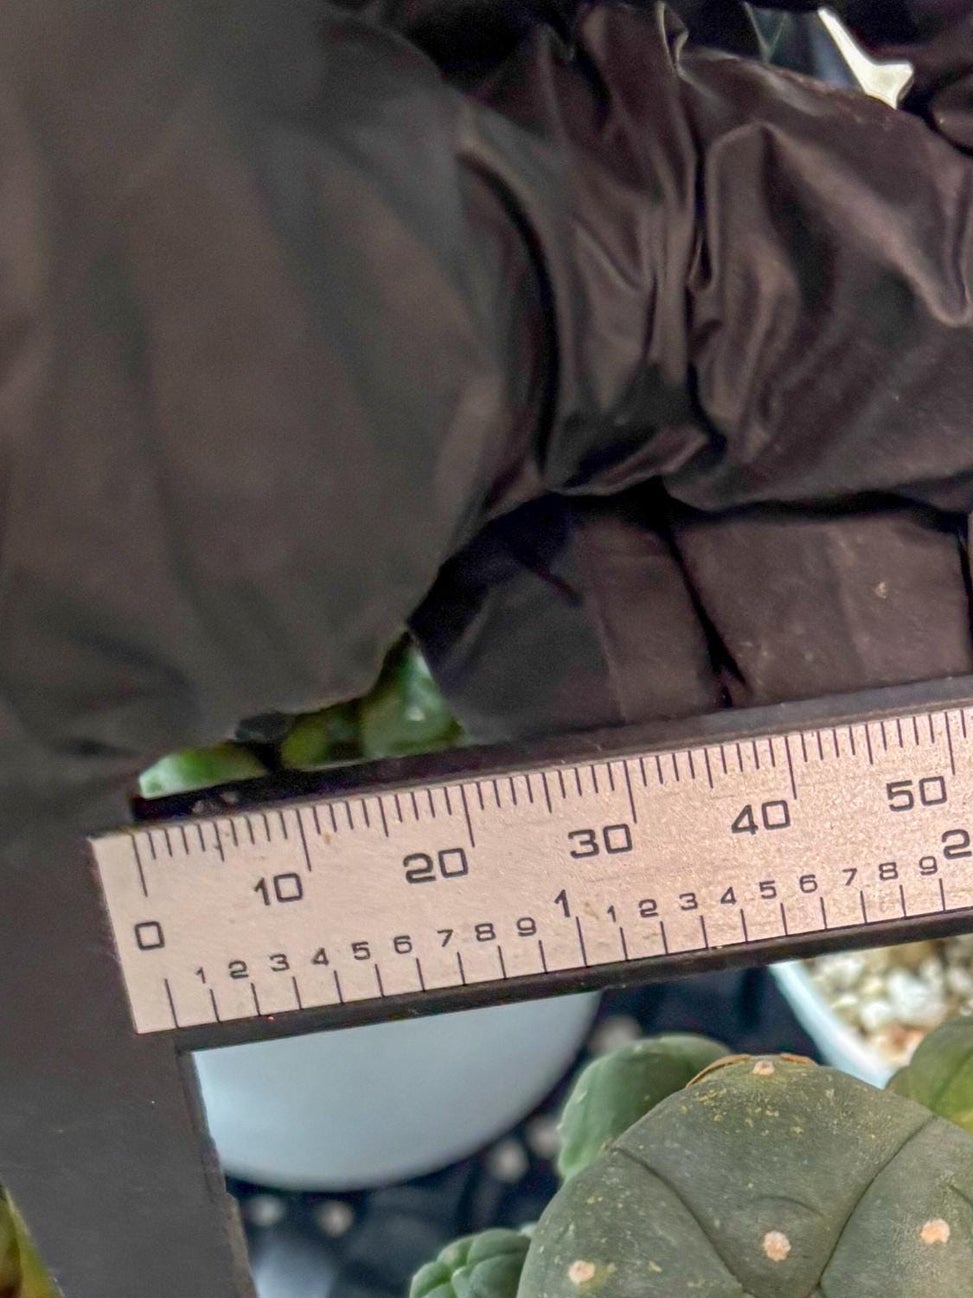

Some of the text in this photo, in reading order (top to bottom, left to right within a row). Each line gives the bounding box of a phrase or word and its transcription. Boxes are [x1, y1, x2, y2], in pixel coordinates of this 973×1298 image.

[134, 921, 165, 950] 0
[254, 873, 303, 906] 10
[403, 848, 468, 884] 20
[567, 823, 633, 859] 30
[731, 800, 791, 835] 40
[886, 775, 948, 812] 50
[195, 967, 206, 984] 1
[228, 960, 249, 979] 2
[270, 953, 290, 973] 3
[310, 948, 329, 966] 4
[351, 941, 371, 961] 5
[393, 935, 412, 954] 6
[437, 929, 454, 948] 7
[474, 923, 496, 942] 8
[516, 917, 537, 937] 9
[554, 889, 571, 918] 1
[607, 905, 617, 923] 1
[638, 899, 659, 918] 2
[679, 893, 699, 911] 3
[720, 887, 737, 906] 4
[758, 880, 778, 900] 5
[799, 874, 818, 893] 6
[842, 868, 858, 886] 7
[878, 861, 899, 881] 8
[918, 856, 939, 876] 9
[941, 828, 972, 860] 2
